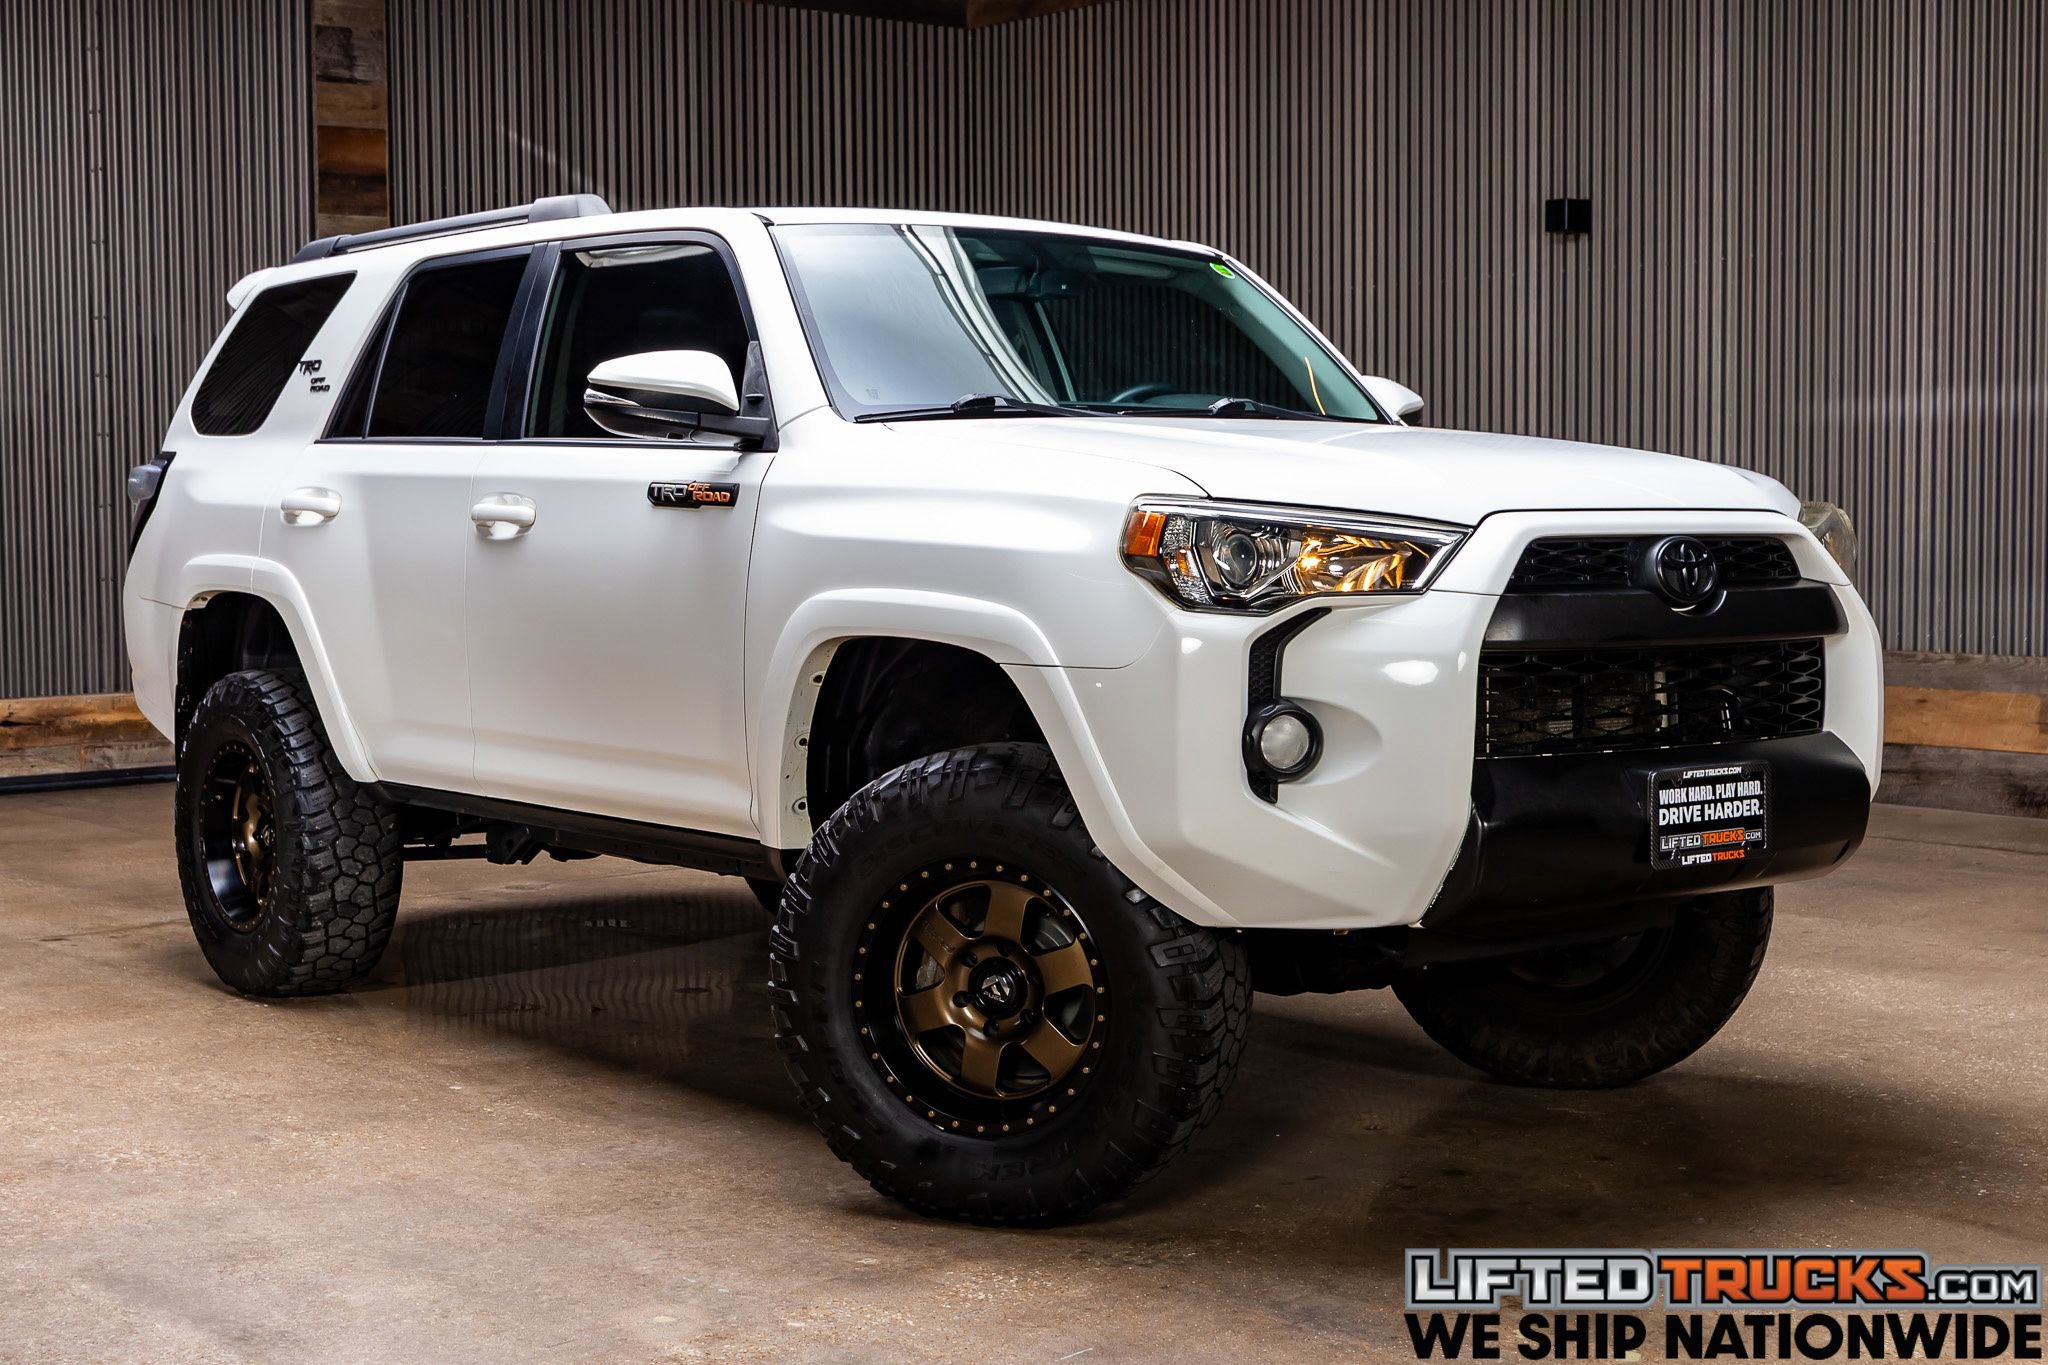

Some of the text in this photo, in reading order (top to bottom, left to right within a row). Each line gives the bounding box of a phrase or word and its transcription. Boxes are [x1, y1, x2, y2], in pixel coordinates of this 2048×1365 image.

[299, 360, 322, 375] TRD
[651, 483, 711, 501] TRD OFF
[693, 491, 731, 502] ROAD
[1659, 780, 1763, 805] WORK HARD. PLAY HARD.
[1659, 798, 1763, 826] DRIVE HARDER.
